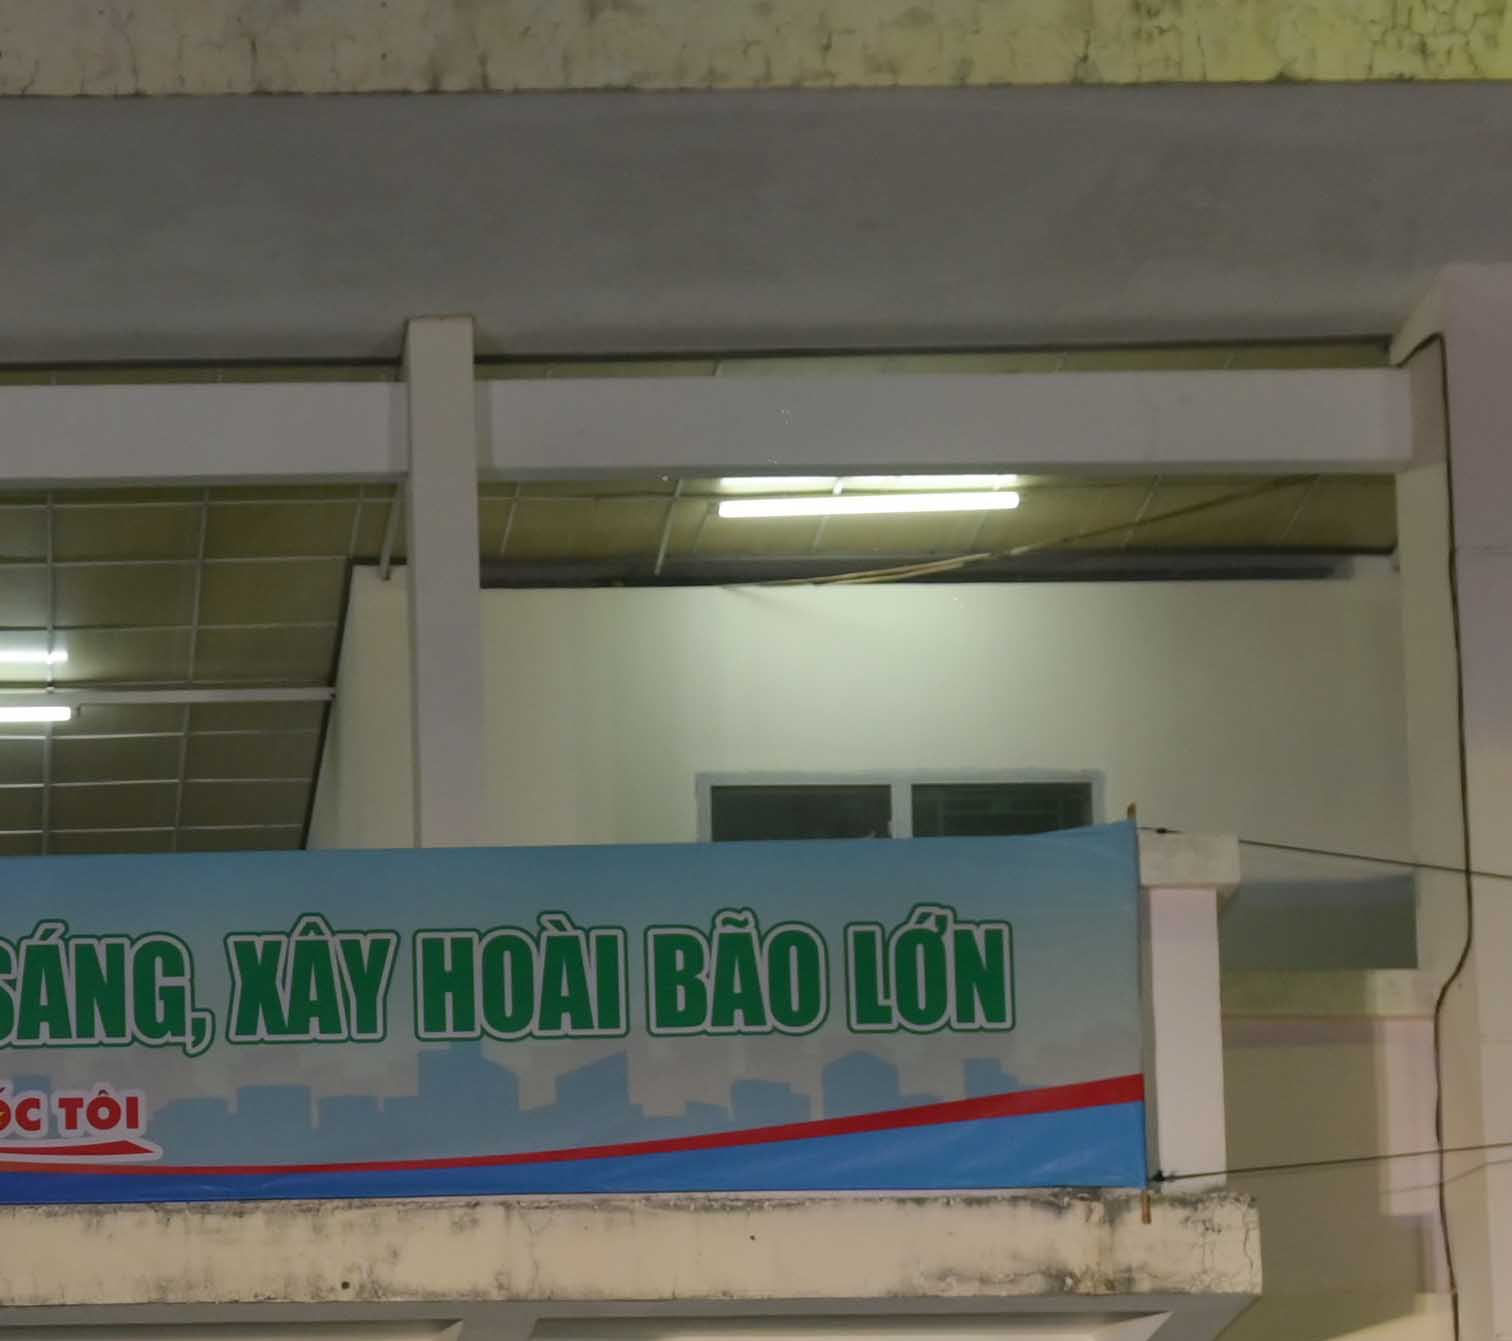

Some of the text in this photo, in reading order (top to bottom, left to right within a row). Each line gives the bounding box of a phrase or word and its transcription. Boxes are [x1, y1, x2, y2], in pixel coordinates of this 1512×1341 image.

[226, 912, 396, 1043] XÂY
[413, 911, 624, 1038] HOÀI
[647, 910, 824, 1034] BÃO
[847, 904, 1012, 1034] LỚN
[59, 1088, 139, 1130] TÔI
